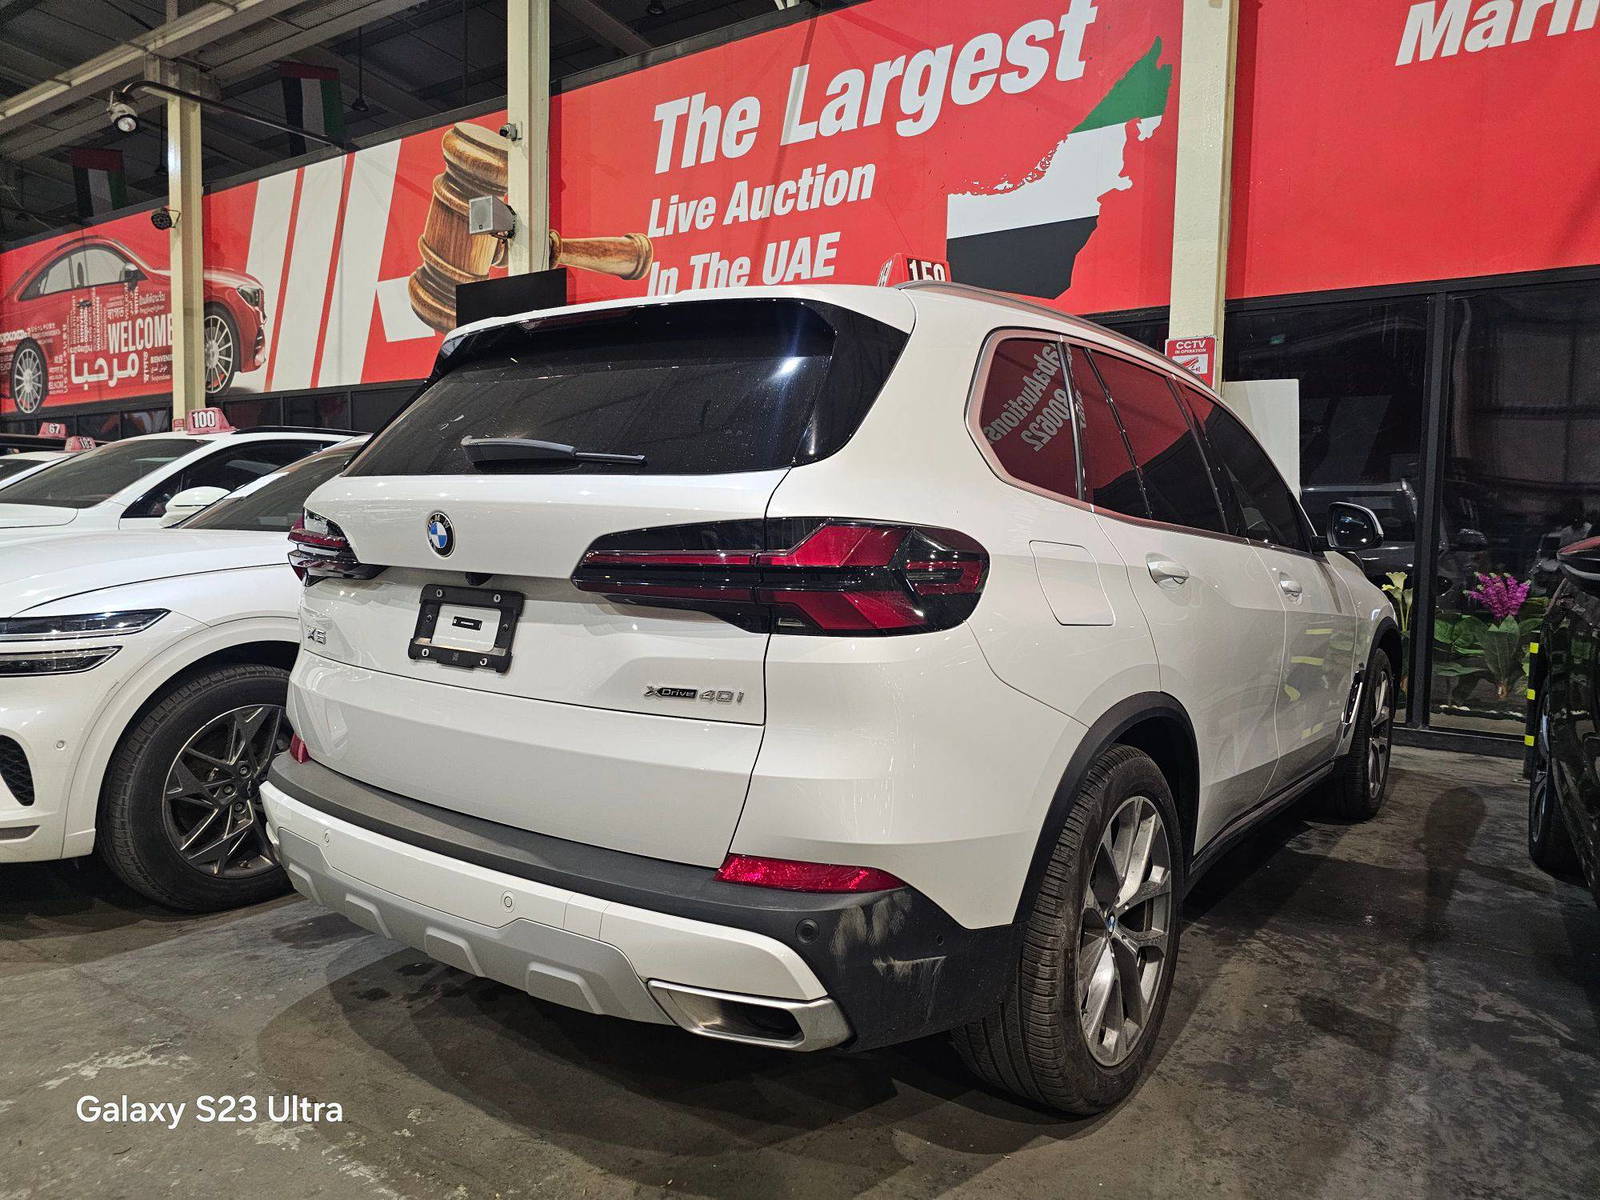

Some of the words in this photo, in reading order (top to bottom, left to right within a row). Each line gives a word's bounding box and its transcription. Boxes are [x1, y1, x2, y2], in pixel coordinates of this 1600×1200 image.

[654, 92, 760, 174] The
[780, 0, 1100, 146] Largest
[648, 195, 716, 238] Live
[722, 163, 876, 226] Auction
[647, 261, 679, 297] In
[689, 252, 750, 290] The
[762, 231, 841, 286] UAE
[1176, 340, 1206, 350] CCTV
[70, 352, 140, 390] مرحبا
[49, 423, 60, 434] 67
[192, 411, 215, 428] 100
